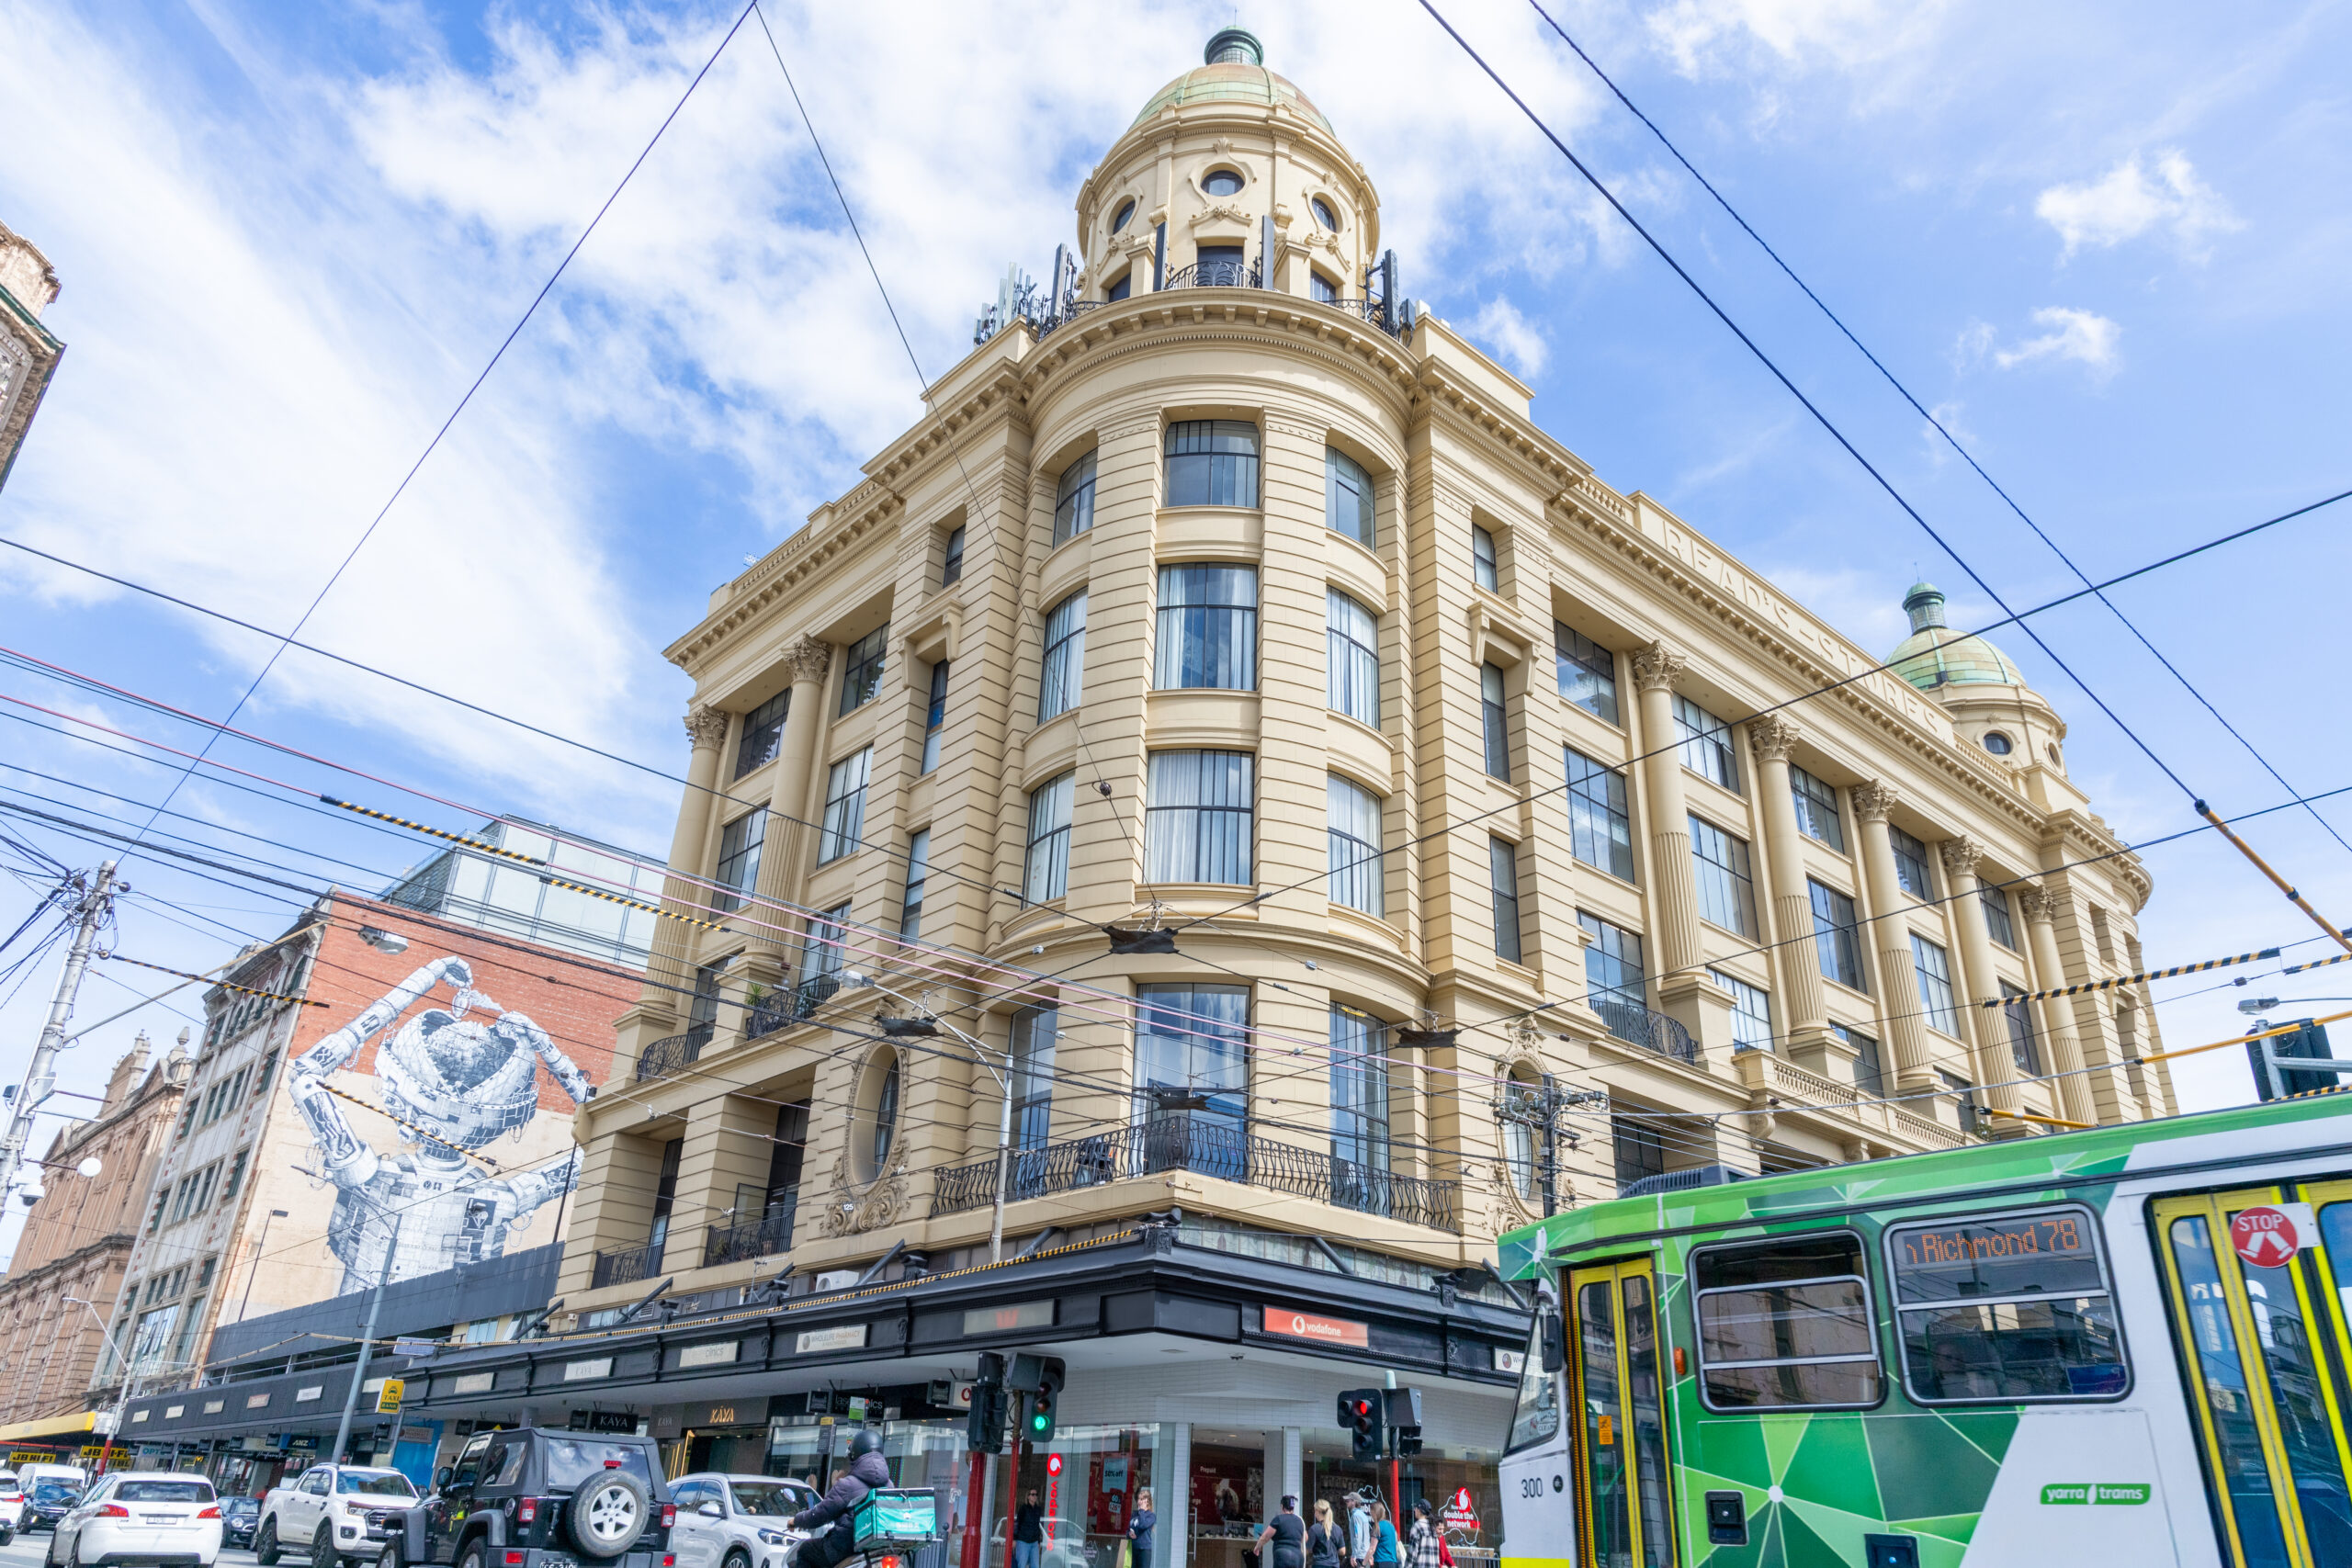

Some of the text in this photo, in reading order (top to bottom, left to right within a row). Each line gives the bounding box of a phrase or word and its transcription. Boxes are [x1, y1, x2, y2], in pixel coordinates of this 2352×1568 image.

[2237, 1213, 2285, 1232] STOP
[1921, 1224, 2039, 1264] Richmond
[2041, 1218, 2079, 1252] 78
[1306, 1322, 1342, 1337] vodafone
[291, 1438, 310, 1447] ANZ
[12, 1453, 28, 1461] JB
[84, 1448, 102, 1457] JB
[1115, 1470, 1124, 1478] off
[1199, 1465, 1216, 1474] Prepaid
[1521, 1476, 1544, 1500] 300
[2045, 1485, 2145, 1503] yarra trams
[1046, 1480, 1058, 1552] vodafone
[1443, 1509, 1475, 1521] double the
[1446, 1520, 1471, 1529] network
